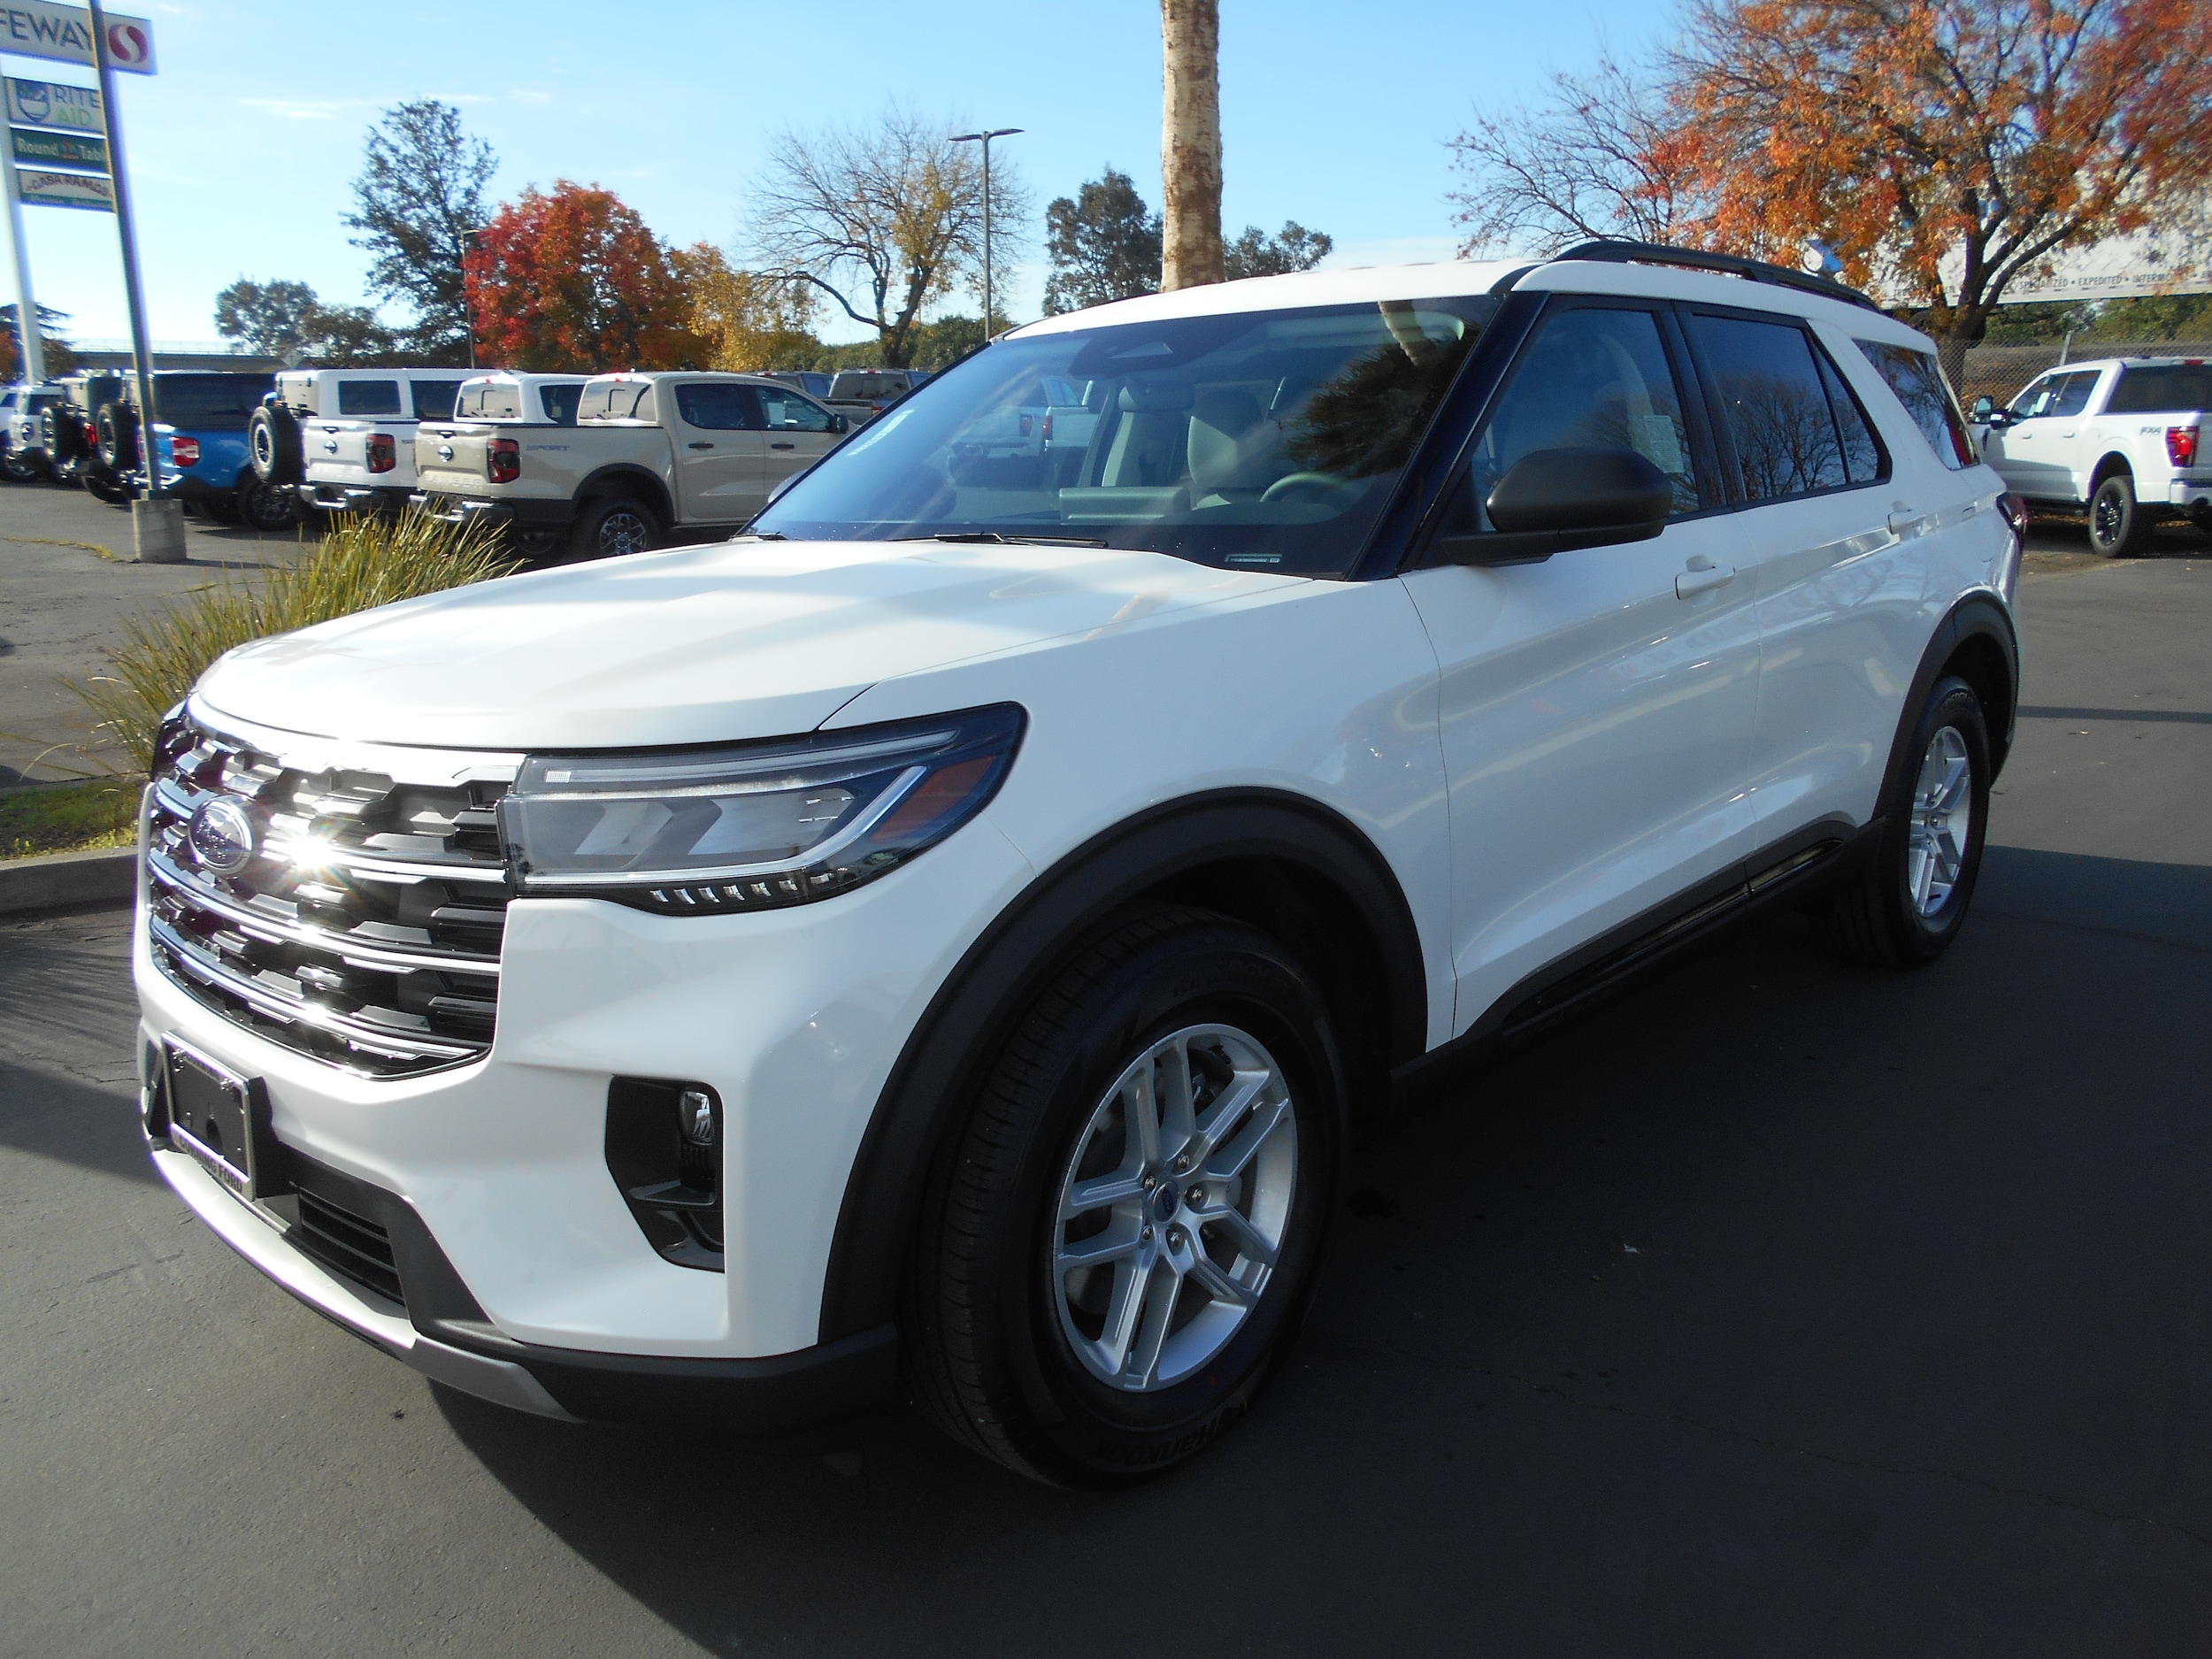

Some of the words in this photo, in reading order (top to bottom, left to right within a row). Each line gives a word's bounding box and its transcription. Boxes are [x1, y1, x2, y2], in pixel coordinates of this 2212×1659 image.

[54, 86, 100, 108] RITE
[57, 108, 93, 126] AID
[18, 137, 58, 156] Round
[2078, 274, 2124, 287] EXPEDITED
[2139, 426, 2162, 435] FX4
